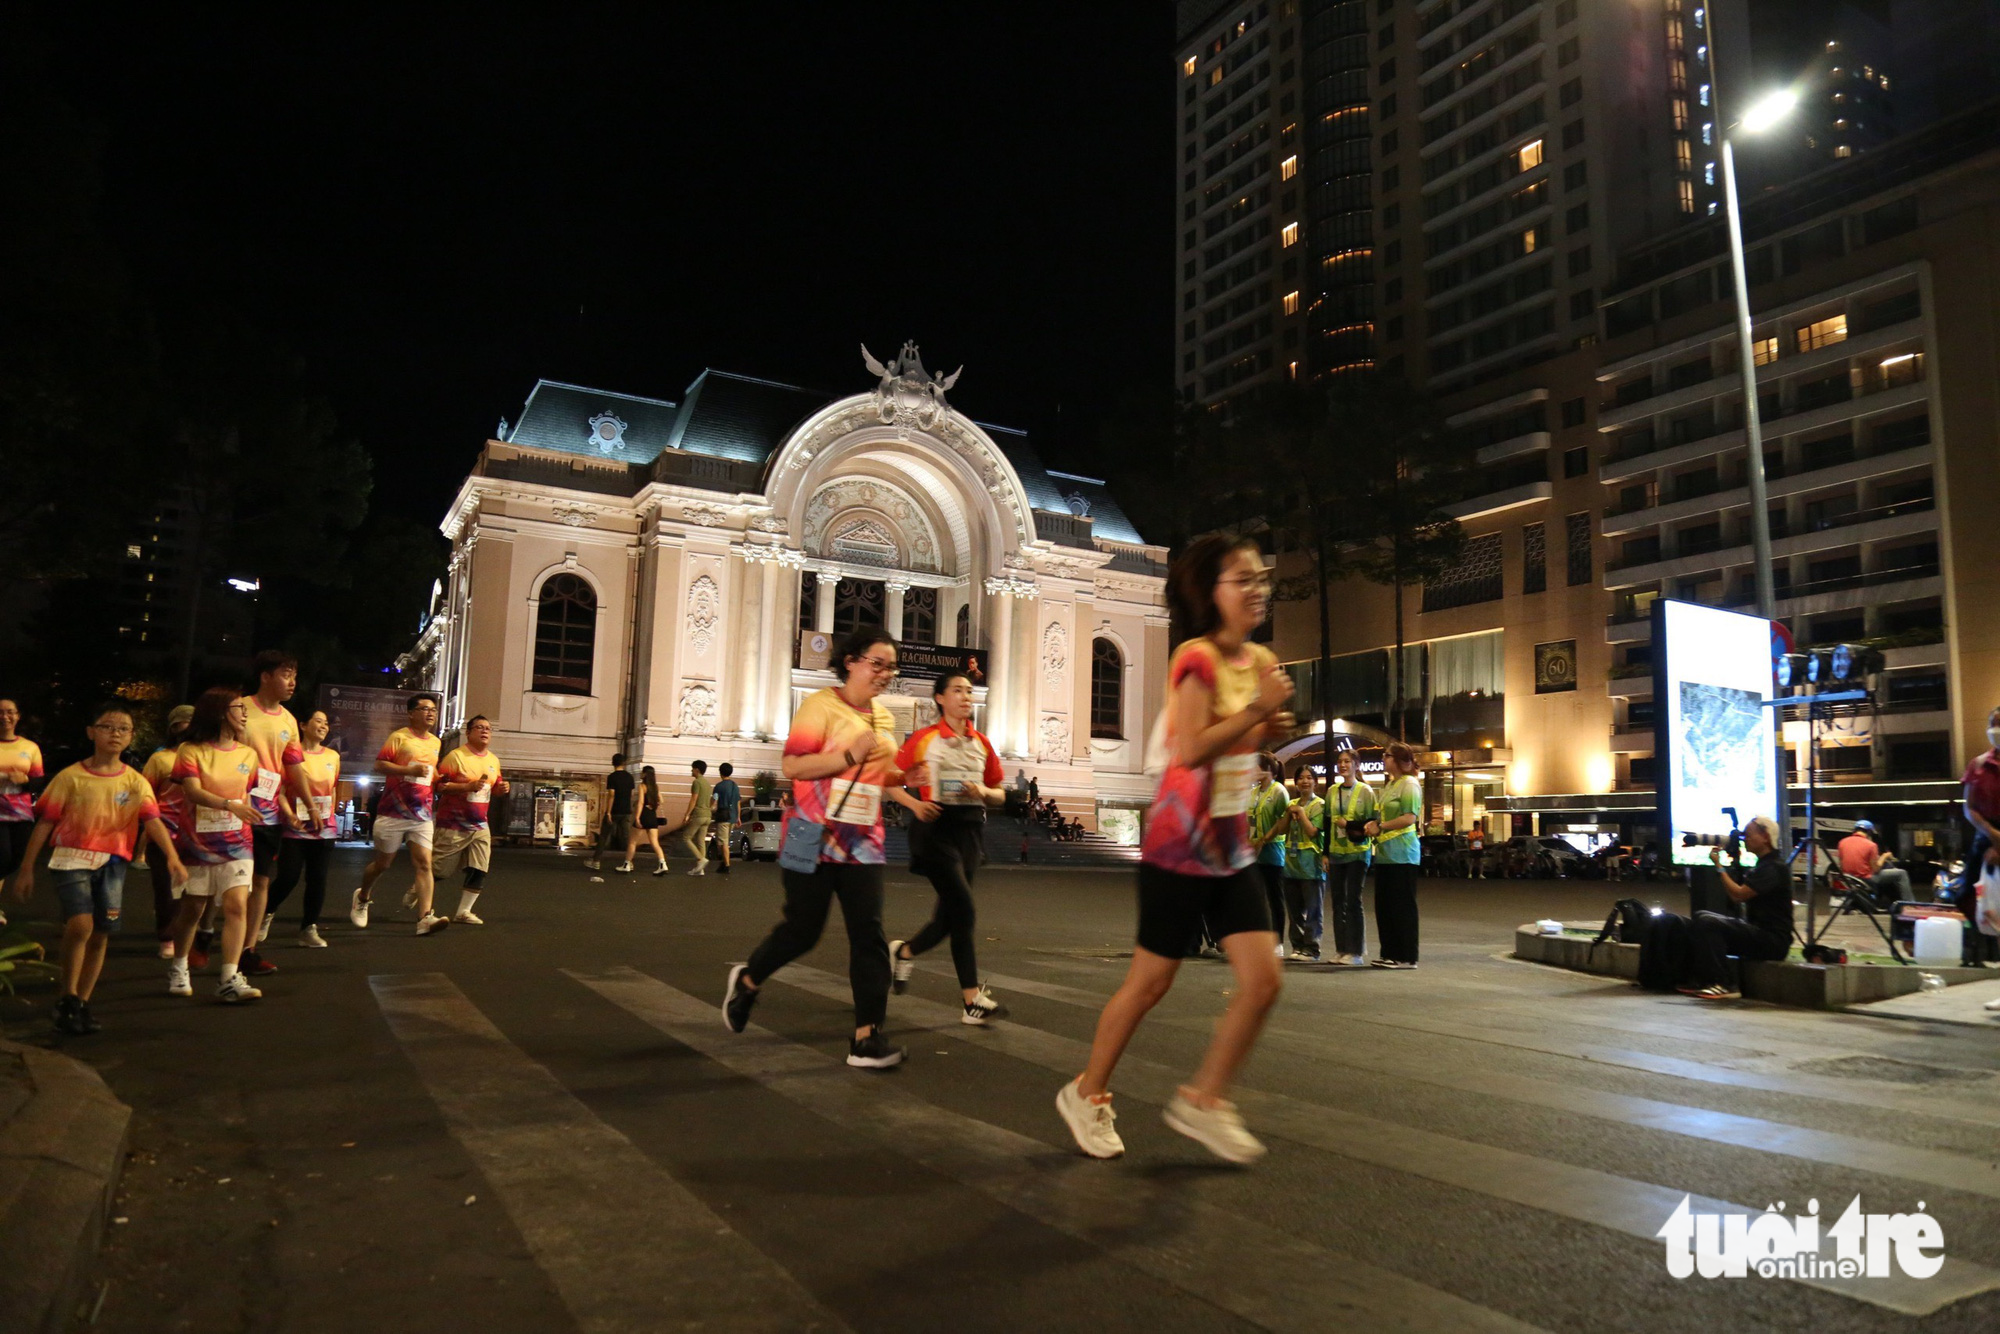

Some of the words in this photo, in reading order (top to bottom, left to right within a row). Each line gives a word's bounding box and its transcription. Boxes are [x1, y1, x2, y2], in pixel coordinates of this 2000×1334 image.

[901, 651, 962, 668] RACHMANINOV
[1549, 659, 1566, 675] 60
[331, 699, 362, 711] SERGEI
[364, 701, 408, 714] RACHMANI
